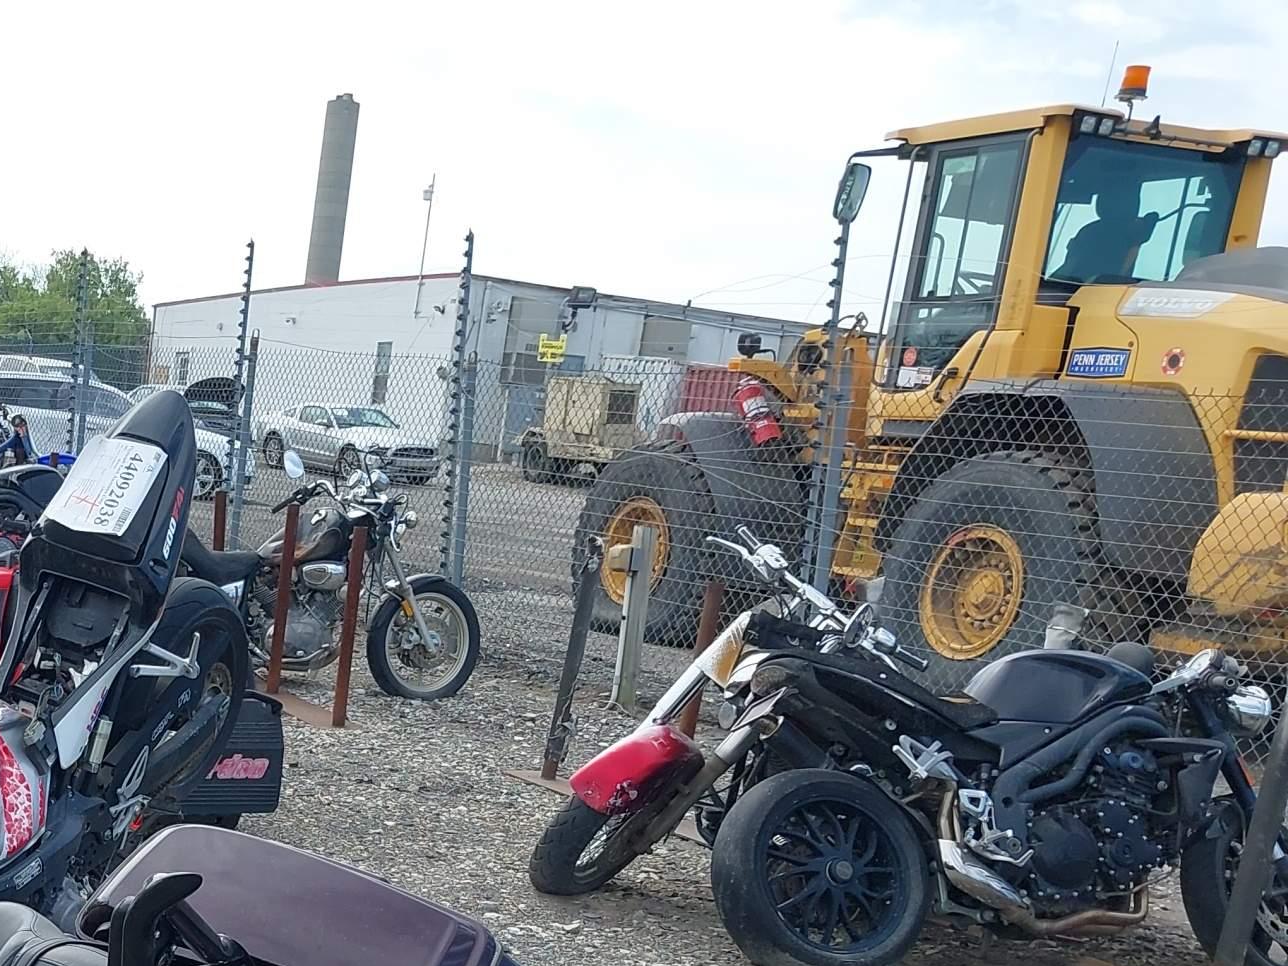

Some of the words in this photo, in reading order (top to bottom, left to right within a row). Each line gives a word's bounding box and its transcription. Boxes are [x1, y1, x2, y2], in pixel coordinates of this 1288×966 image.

[1073, 354, 1096, 366] PENN
[1096, 354, 1126, 366] JERSEY
[93, 452, 144, 527] 44092038
